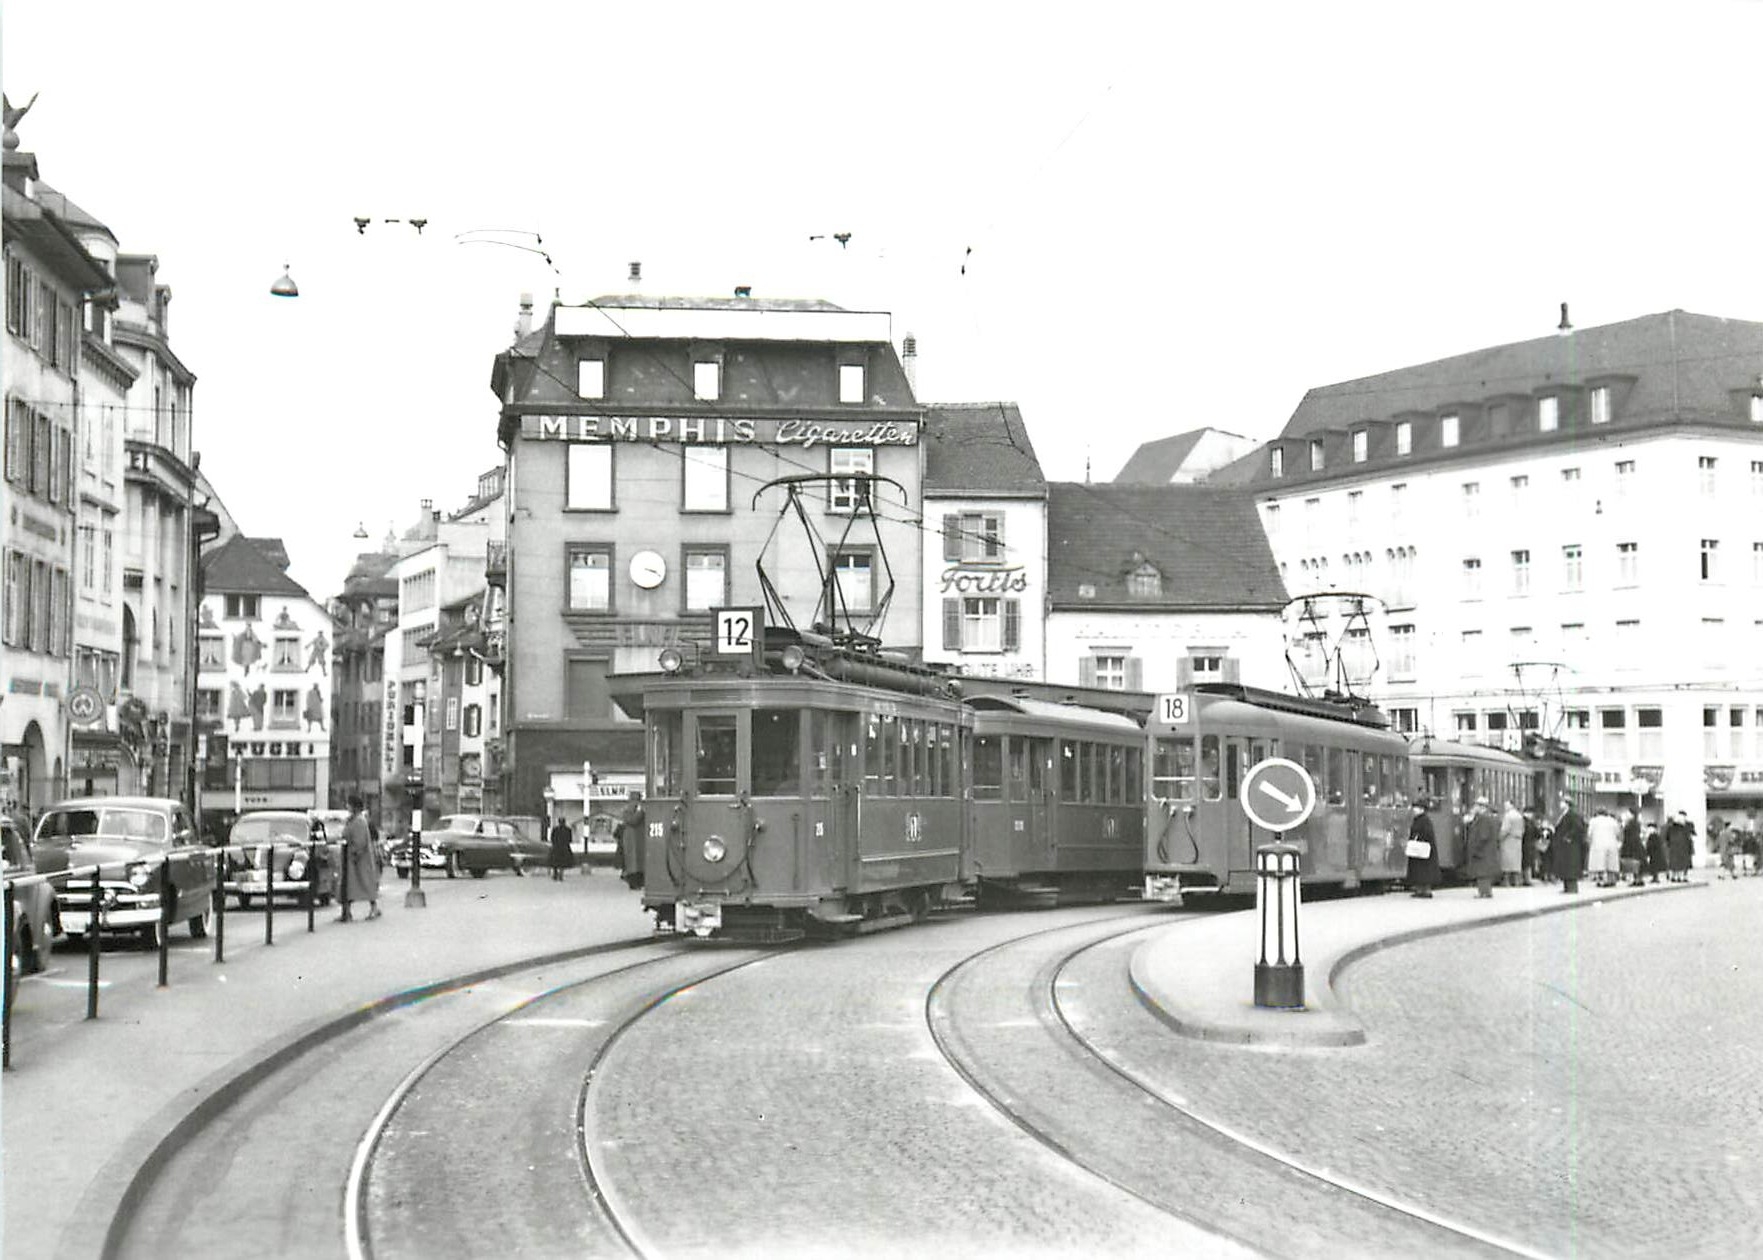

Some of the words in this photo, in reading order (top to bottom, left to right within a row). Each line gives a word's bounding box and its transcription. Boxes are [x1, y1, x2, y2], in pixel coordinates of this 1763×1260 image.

[538, 415, 757, 441] MEMPHIS
[775, 418, 918, 448] Cigaretten
[940, 565, 1028, 593] Fortis
[724, 617, 749, 646] 12
[1165, 698, 1184, 719] 18
